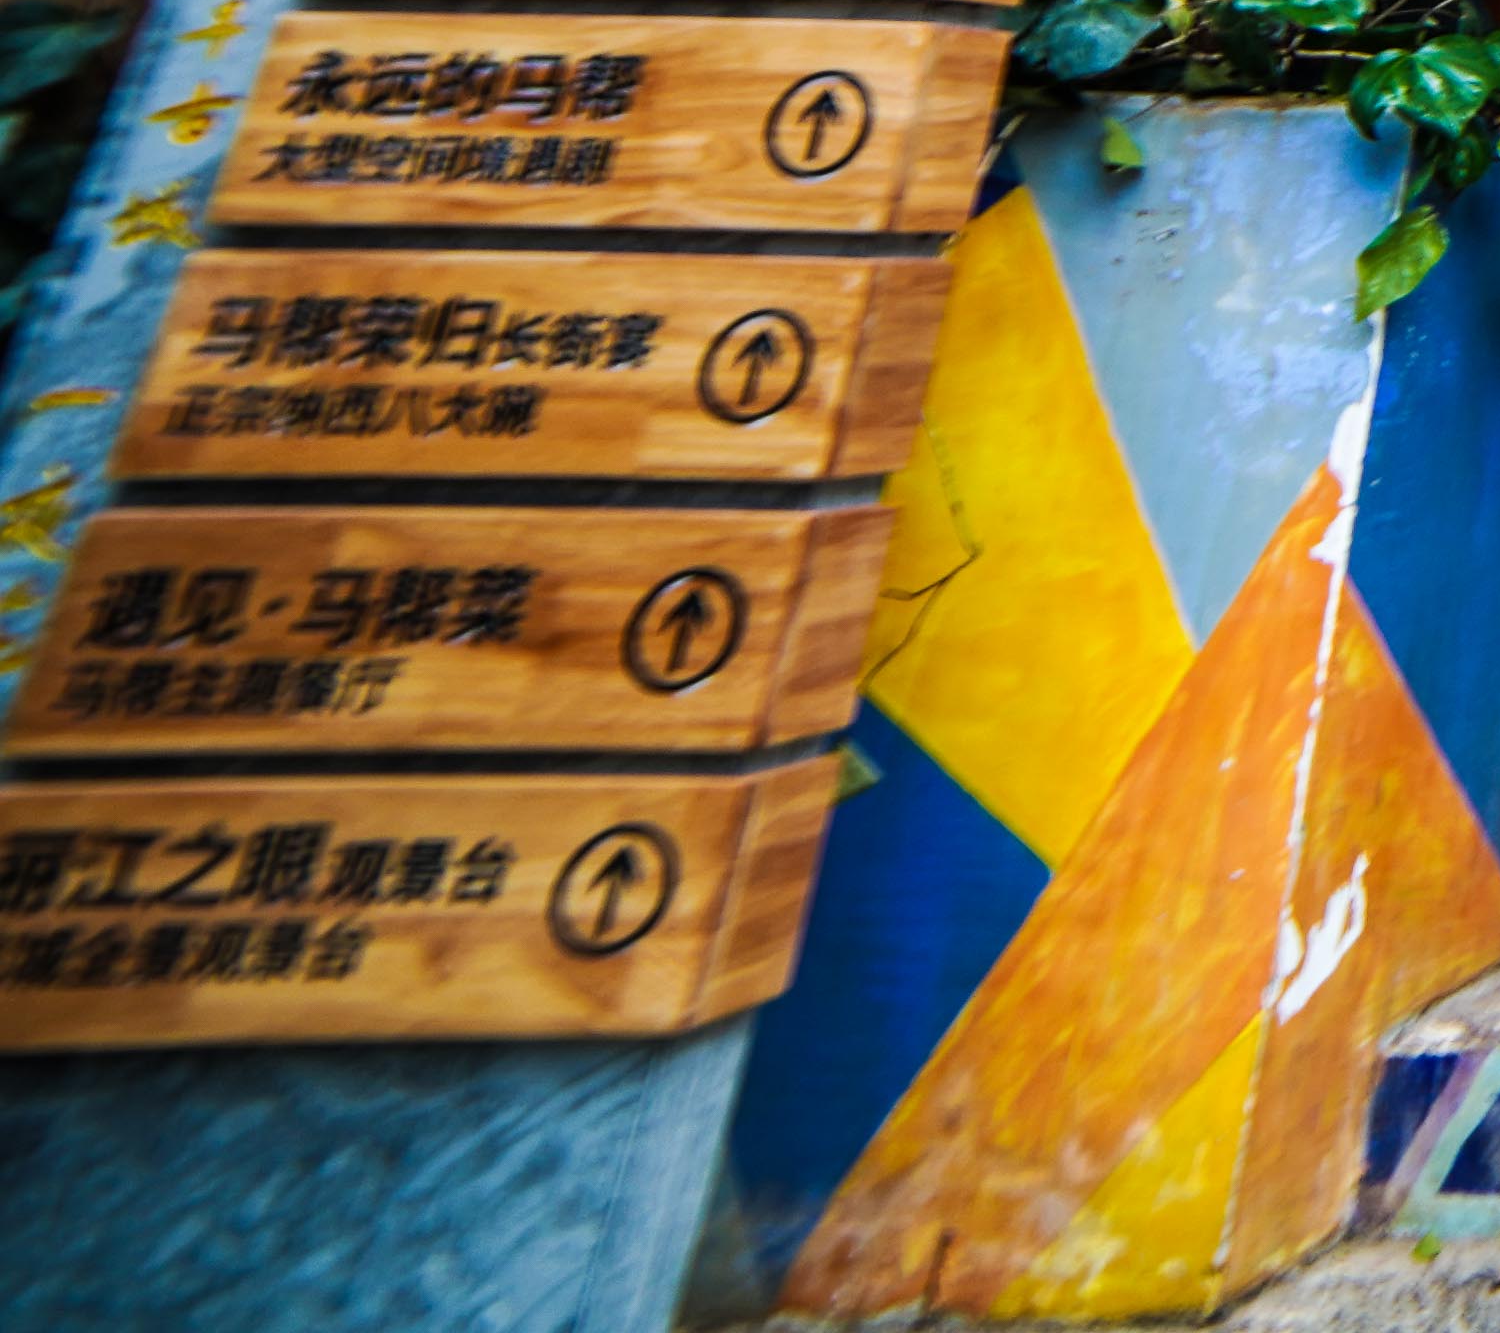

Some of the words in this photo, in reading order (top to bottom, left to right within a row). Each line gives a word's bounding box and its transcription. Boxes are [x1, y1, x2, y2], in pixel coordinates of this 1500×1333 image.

[278, 48, 650, 121] 永远的马帮
